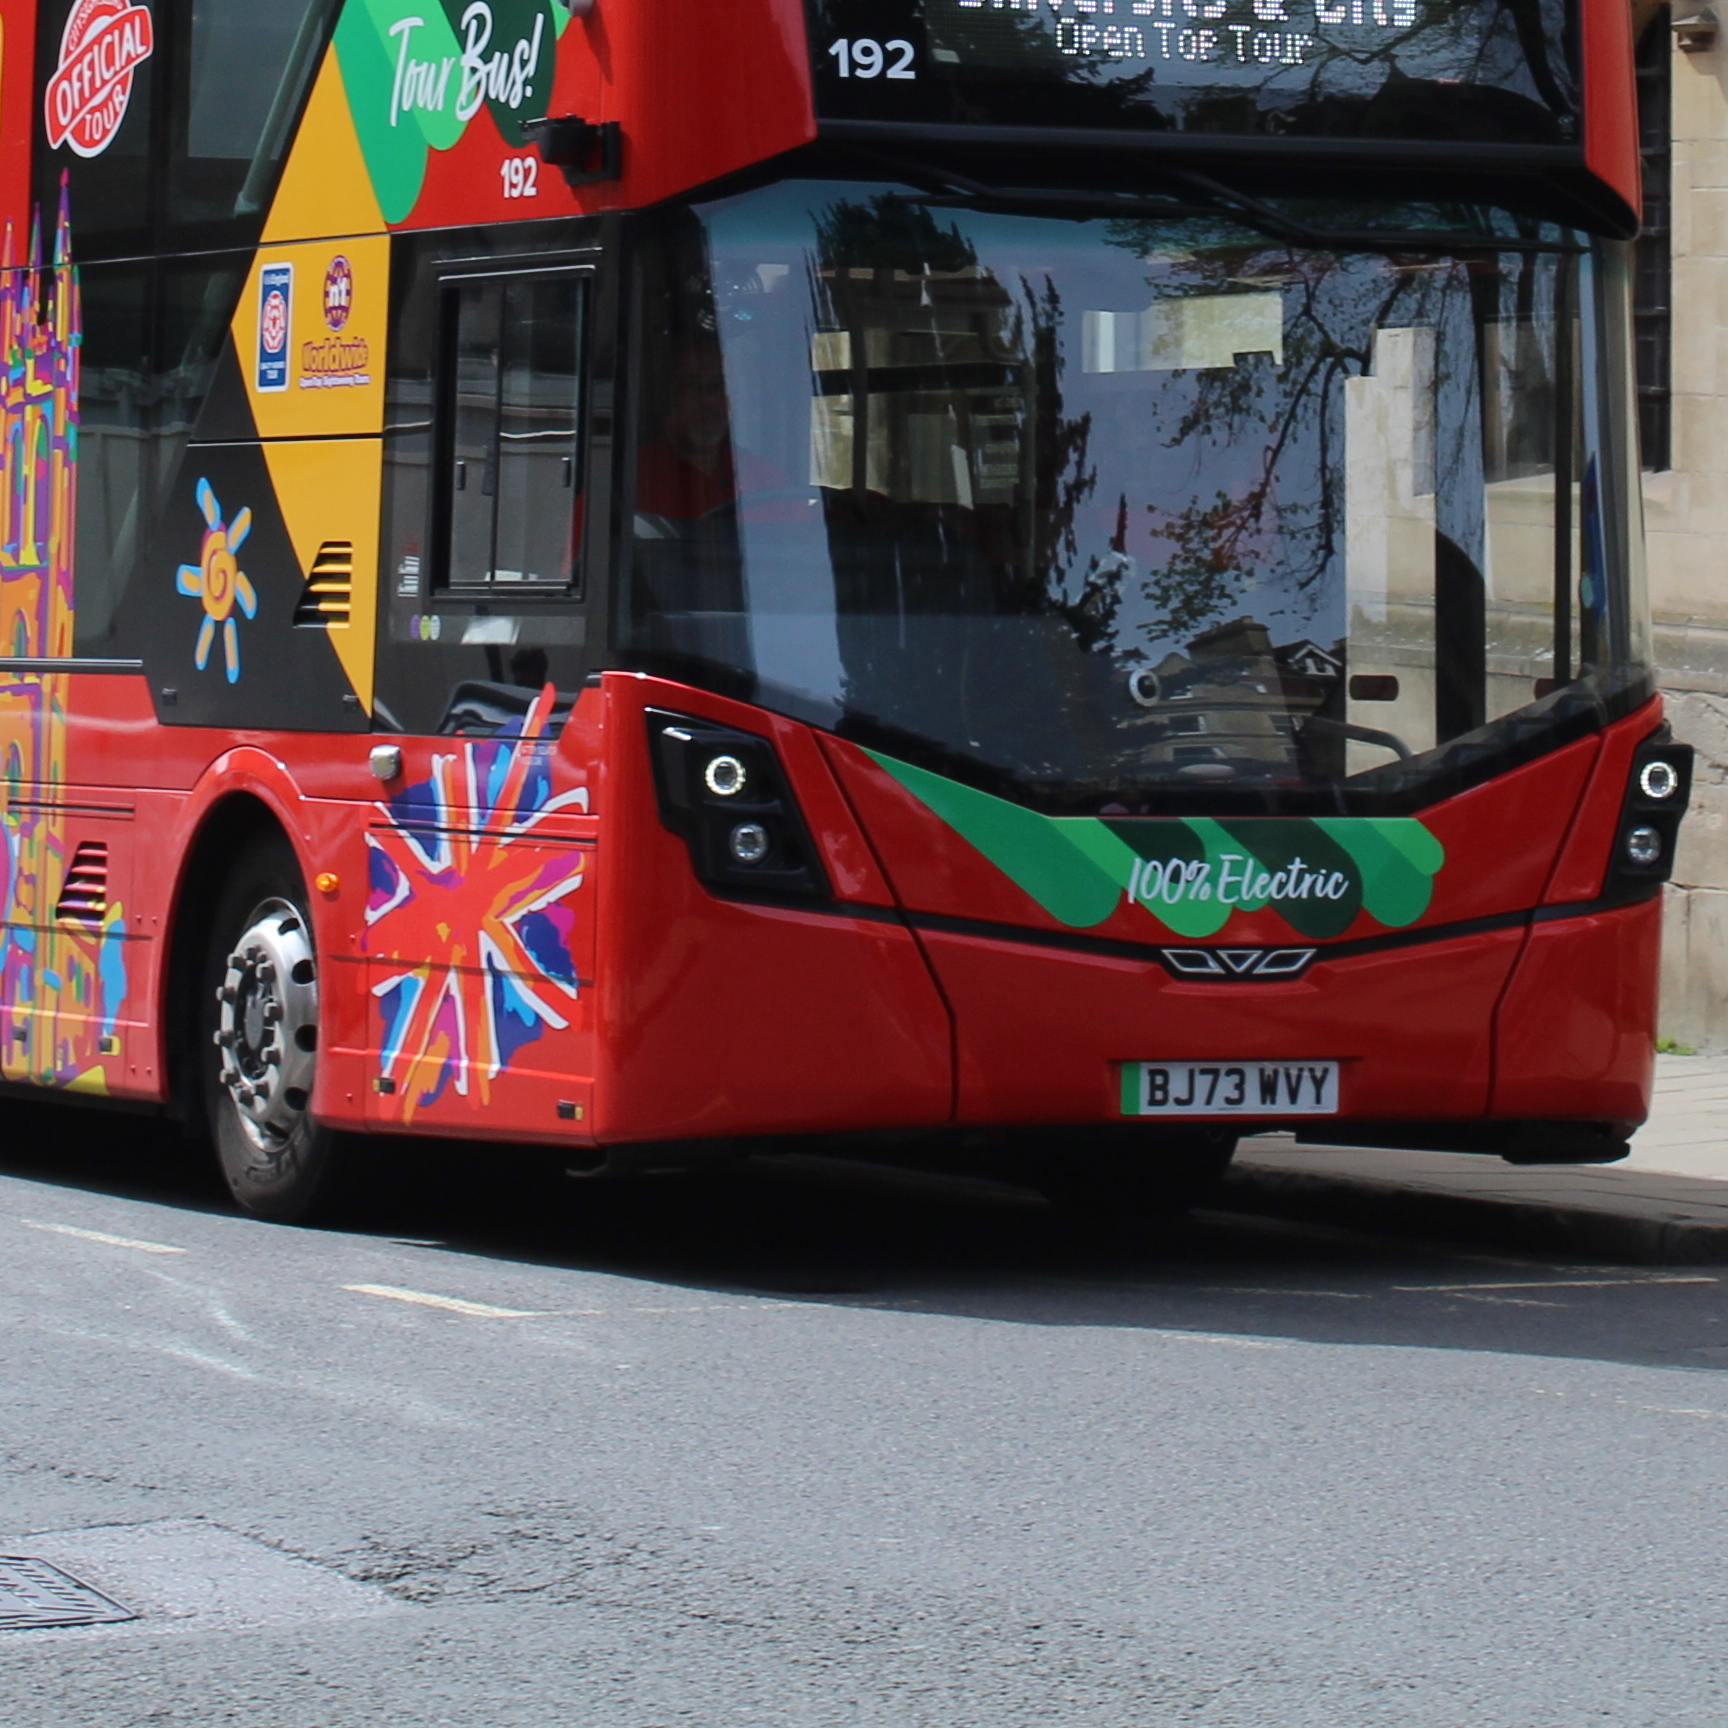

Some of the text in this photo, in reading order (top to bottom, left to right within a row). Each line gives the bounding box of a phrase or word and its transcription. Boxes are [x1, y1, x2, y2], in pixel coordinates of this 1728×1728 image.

[389, 1, 545, 127] Tour Bus!
[828, 39, 916, 80] 192
[1056, 18, 1313, 65] Open Top Tour
[56, 16, 147, 126] OFFICIAL
[83, 83, 125, 141] TOUR
[500, 156, 538, 199] 192
[302, 336, 369, 372] Worldwide
[1127, 853, 1349, 904] 100% Electric
[1147, 1067, 1330, 1107] BJ73 WVY
